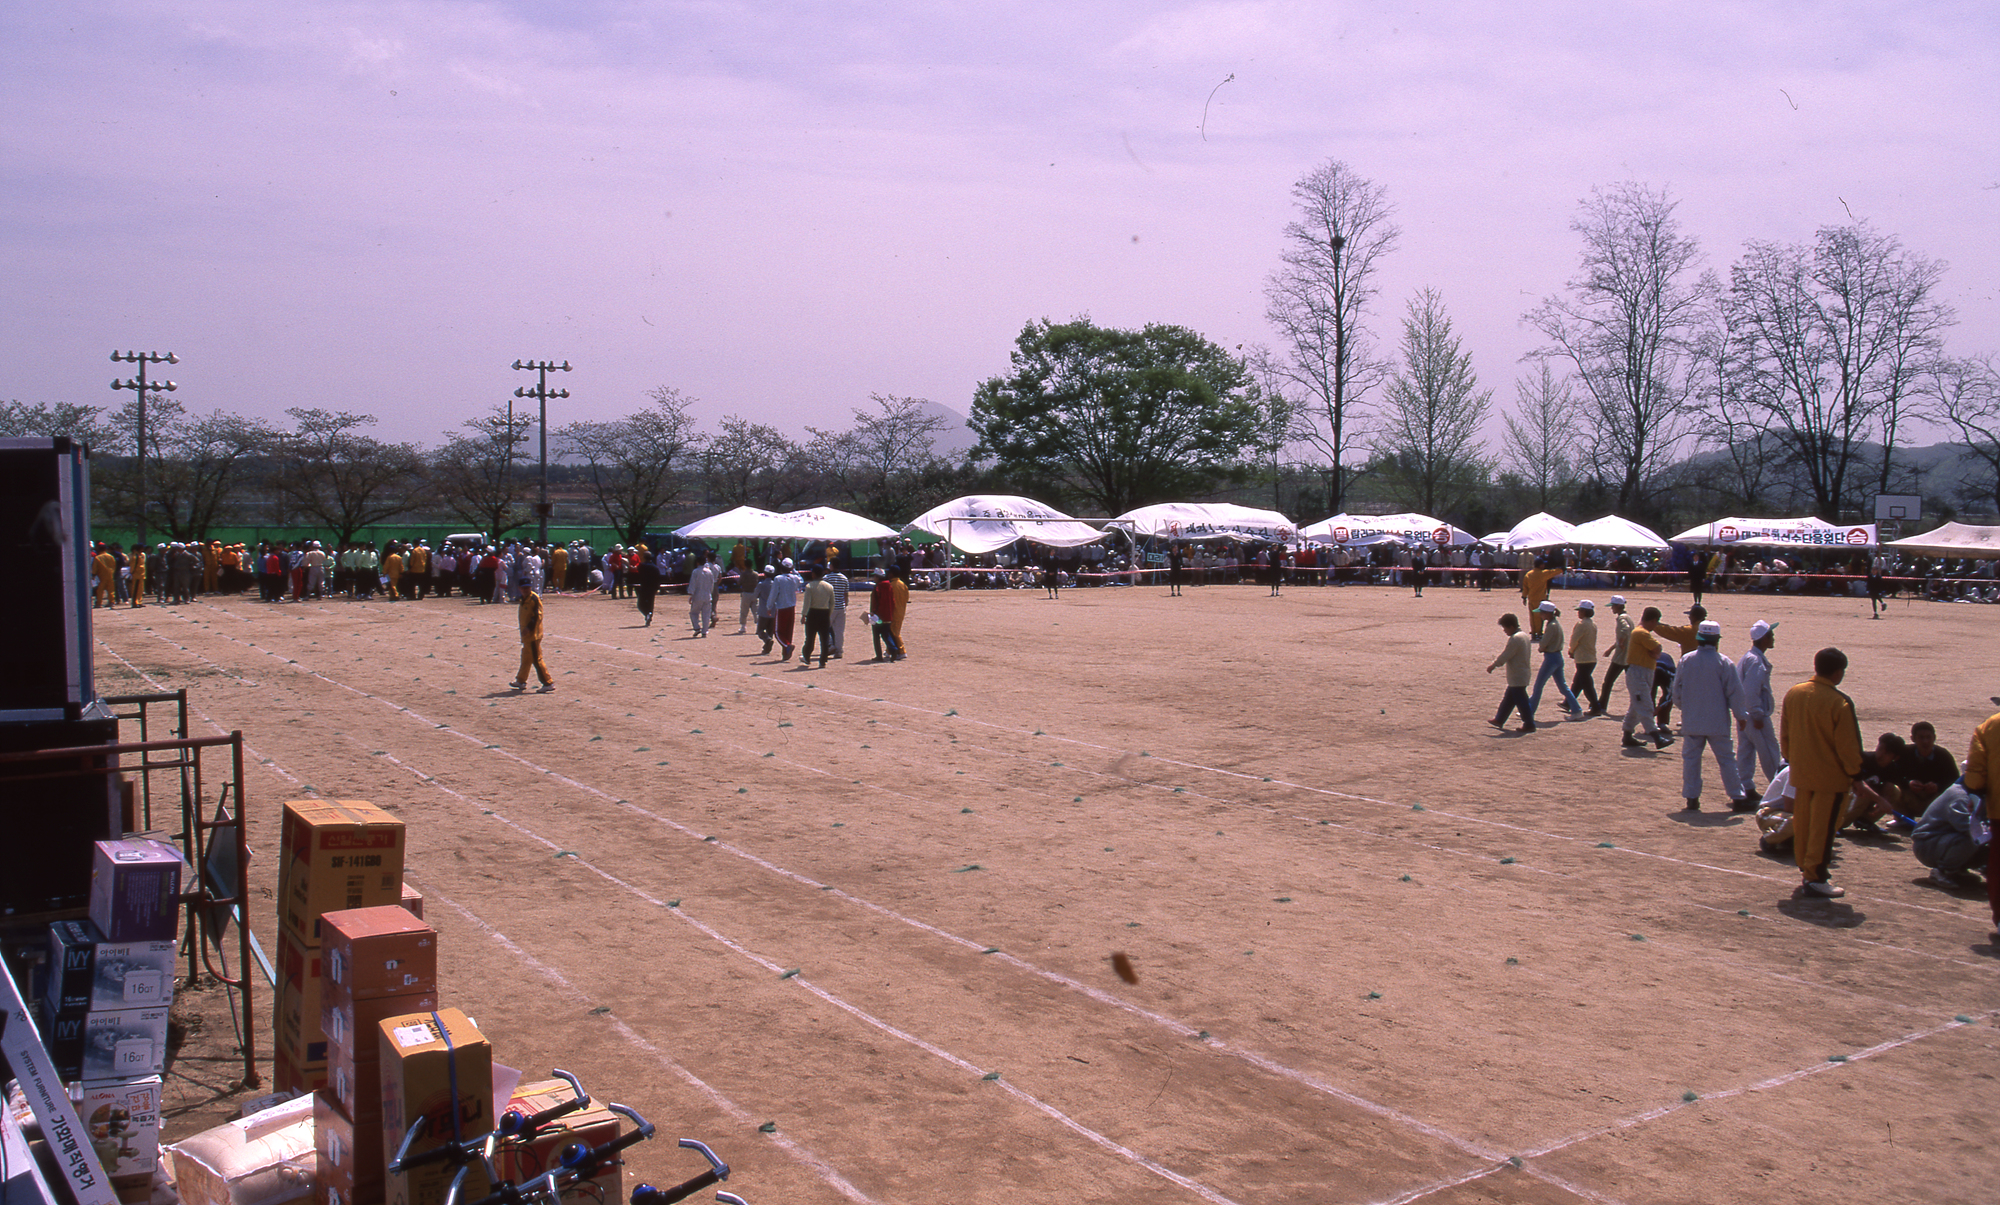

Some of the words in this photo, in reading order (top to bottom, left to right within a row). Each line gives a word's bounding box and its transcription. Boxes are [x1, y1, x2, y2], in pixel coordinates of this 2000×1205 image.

[68, 950, 90, 968] IVY
[58, 1020, 82, 1038] IVY
[21, 1050, 38, 1077] SYSTEM
[33, 1077, 56, 1114] FURNITURE
[48, 1115, 97, 1191] 가화매직행거
